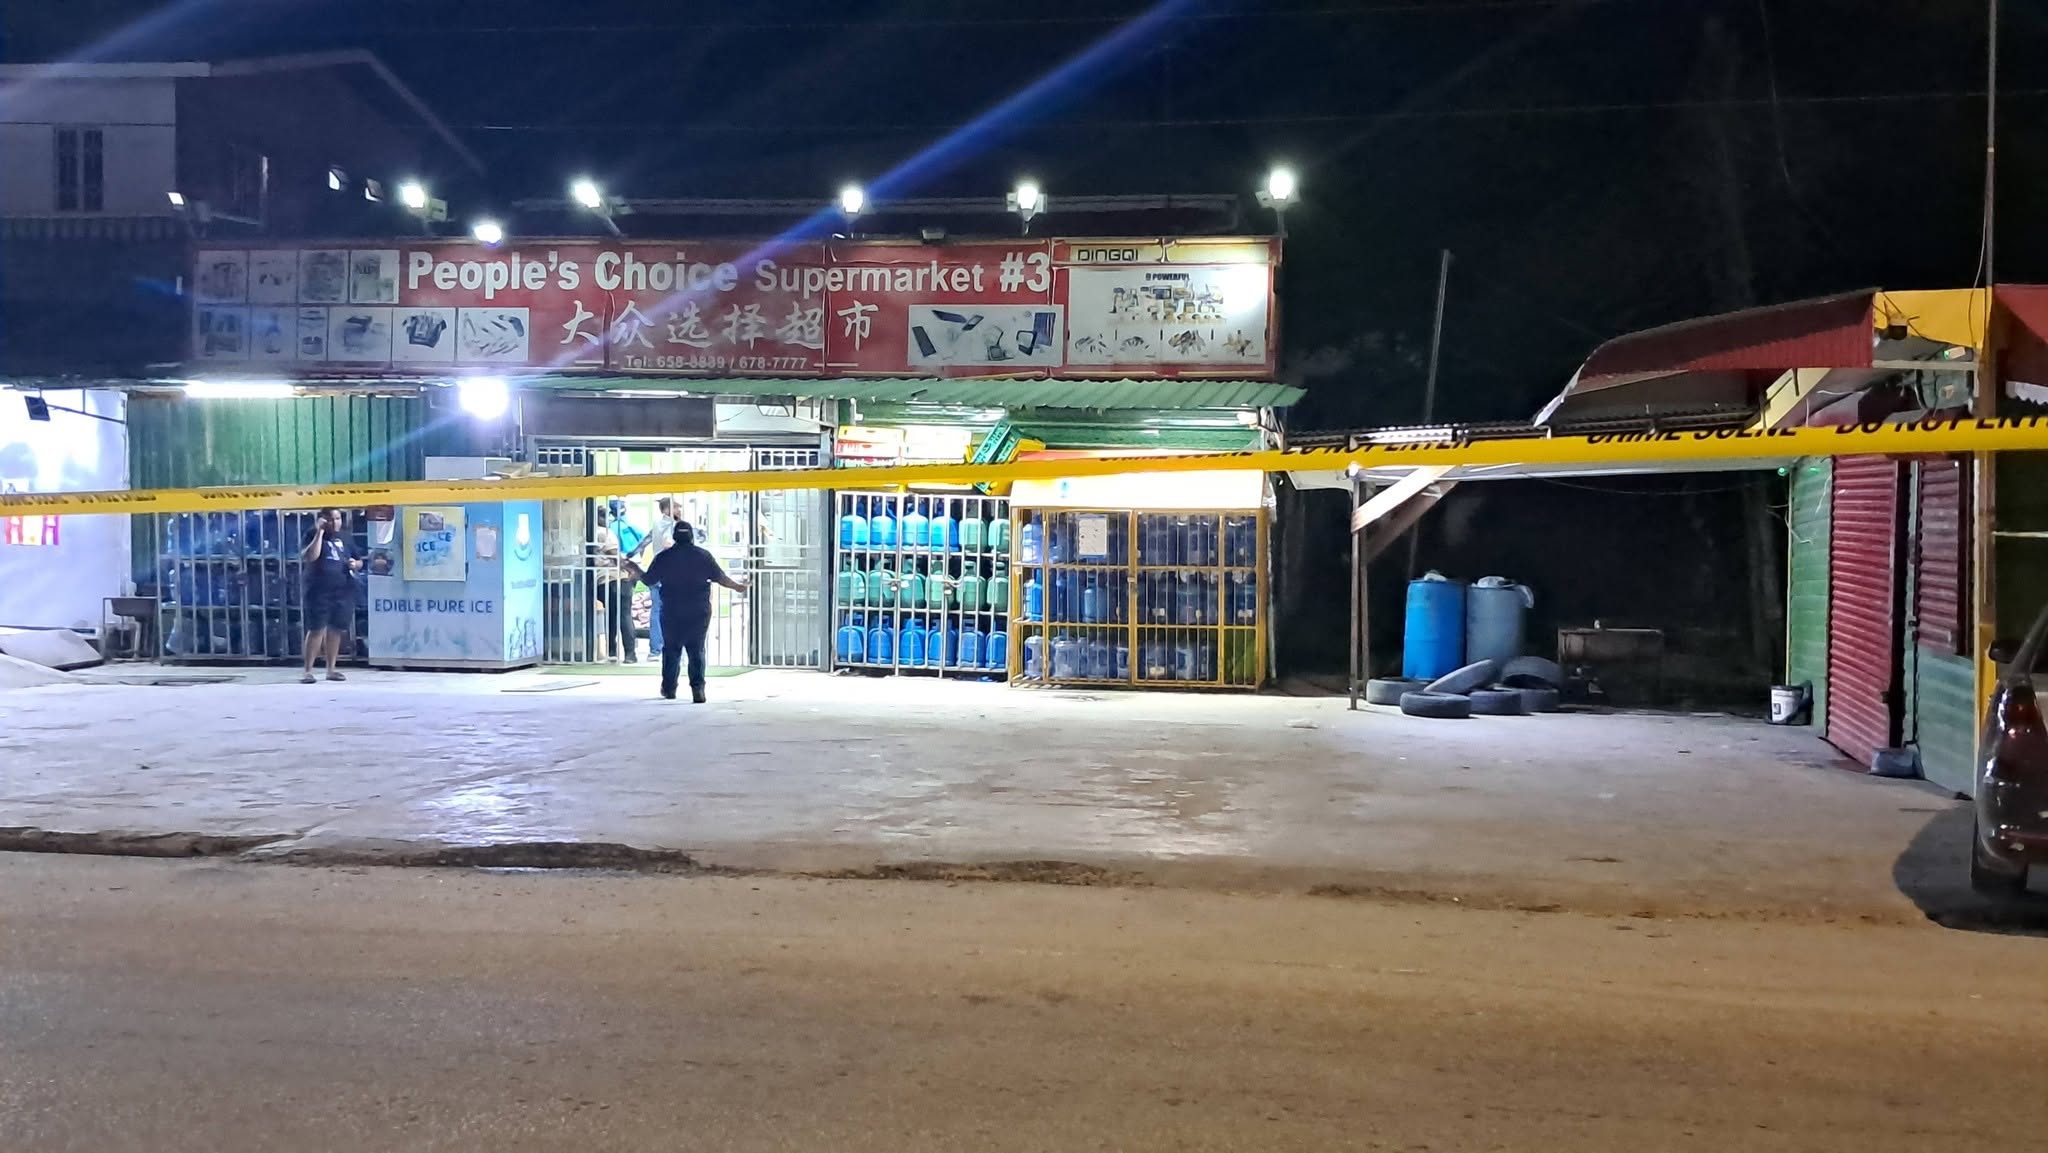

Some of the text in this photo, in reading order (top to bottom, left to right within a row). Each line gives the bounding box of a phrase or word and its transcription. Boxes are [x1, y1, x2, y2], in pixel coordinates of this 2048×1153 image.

[1077, 248, 1139, 262] DINGQI
[594, 251, 738, 291] Choice
[755, 259, 984, 299] Supermarket
[1000, 251, 1050, 293] #3
[625, 354, 650, 368] Tel:
[738, 357, 808, 370] 678-7777
[417, 541, 436, 553] ICE
[374, 599, 492, 613] EDIBLE PURE ICE
